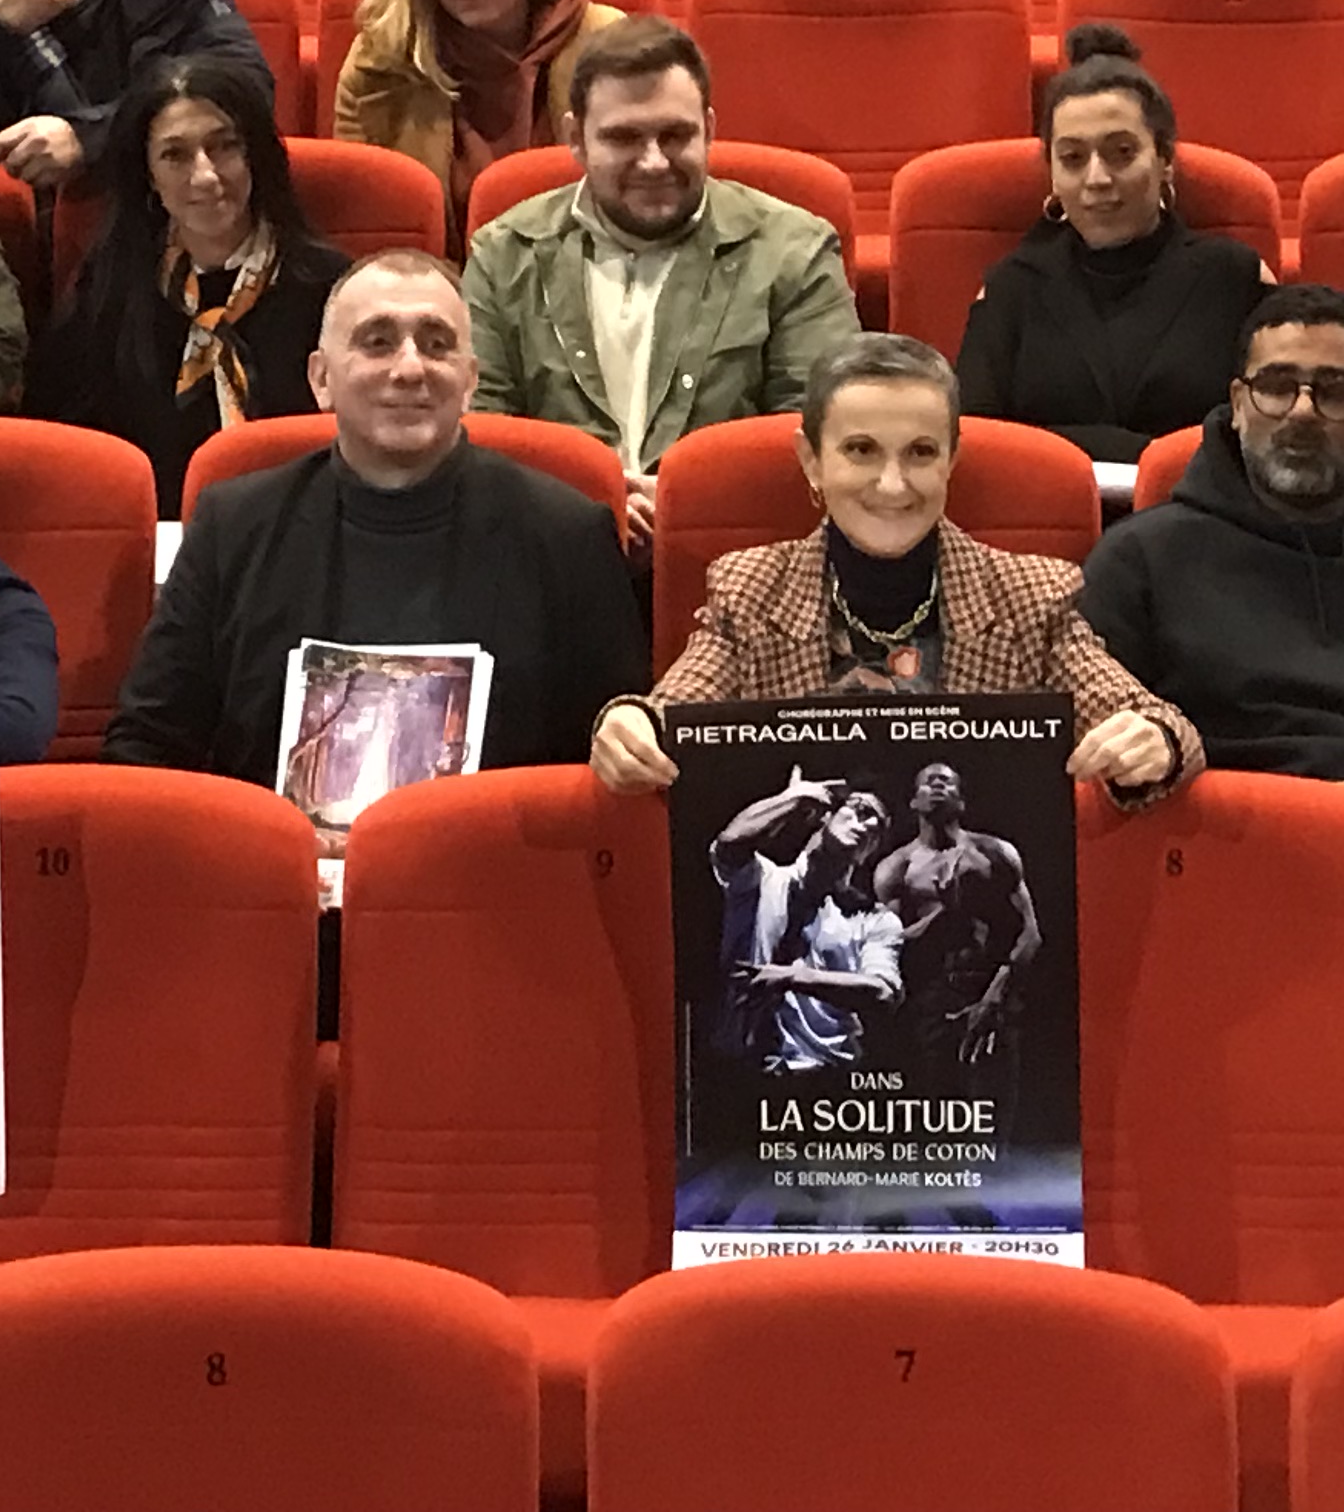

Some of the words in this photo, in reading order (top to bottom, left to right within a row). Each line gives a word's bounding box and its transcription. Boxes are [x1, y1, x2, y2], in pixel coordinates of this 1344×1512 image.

[676, 721, 866, 744] PIETRAGALLA
[890, 719, 1061, 741] DEROUAULT
[36, 840, 82, 877] 10
[594, 848, 614, 881] 9
[1166, 850, 1184, 877] 8
[851, 1072, 904, 1090] DANS
[760, 1099, 804, 1132] LA
[813, 1099, 995, 1134] SOLITUDE
[759, 1142, 797, 1161] DES
[805, 1142, 885, 1161] CHAMPS
[893, 1143, 918, 1161] DE
[925, 1143, 997, 1162] COTON
[775, 1171, 793, 1186] DE
[798, 1171, 919, 1187] BERNARD-MARIE
[924, 1169, 982, 1187] KOLTÈS
[701, 1242, 820, 1258] VENDREDI
[828, 1240, 853, 1255] 26
[861, 1239, 963, 1255] JANVIER
[984, 1240, 1060, 1256] 20H30
[205, 1352, 228, 1387] 8
[894, 1348, 916, 1382] 7
